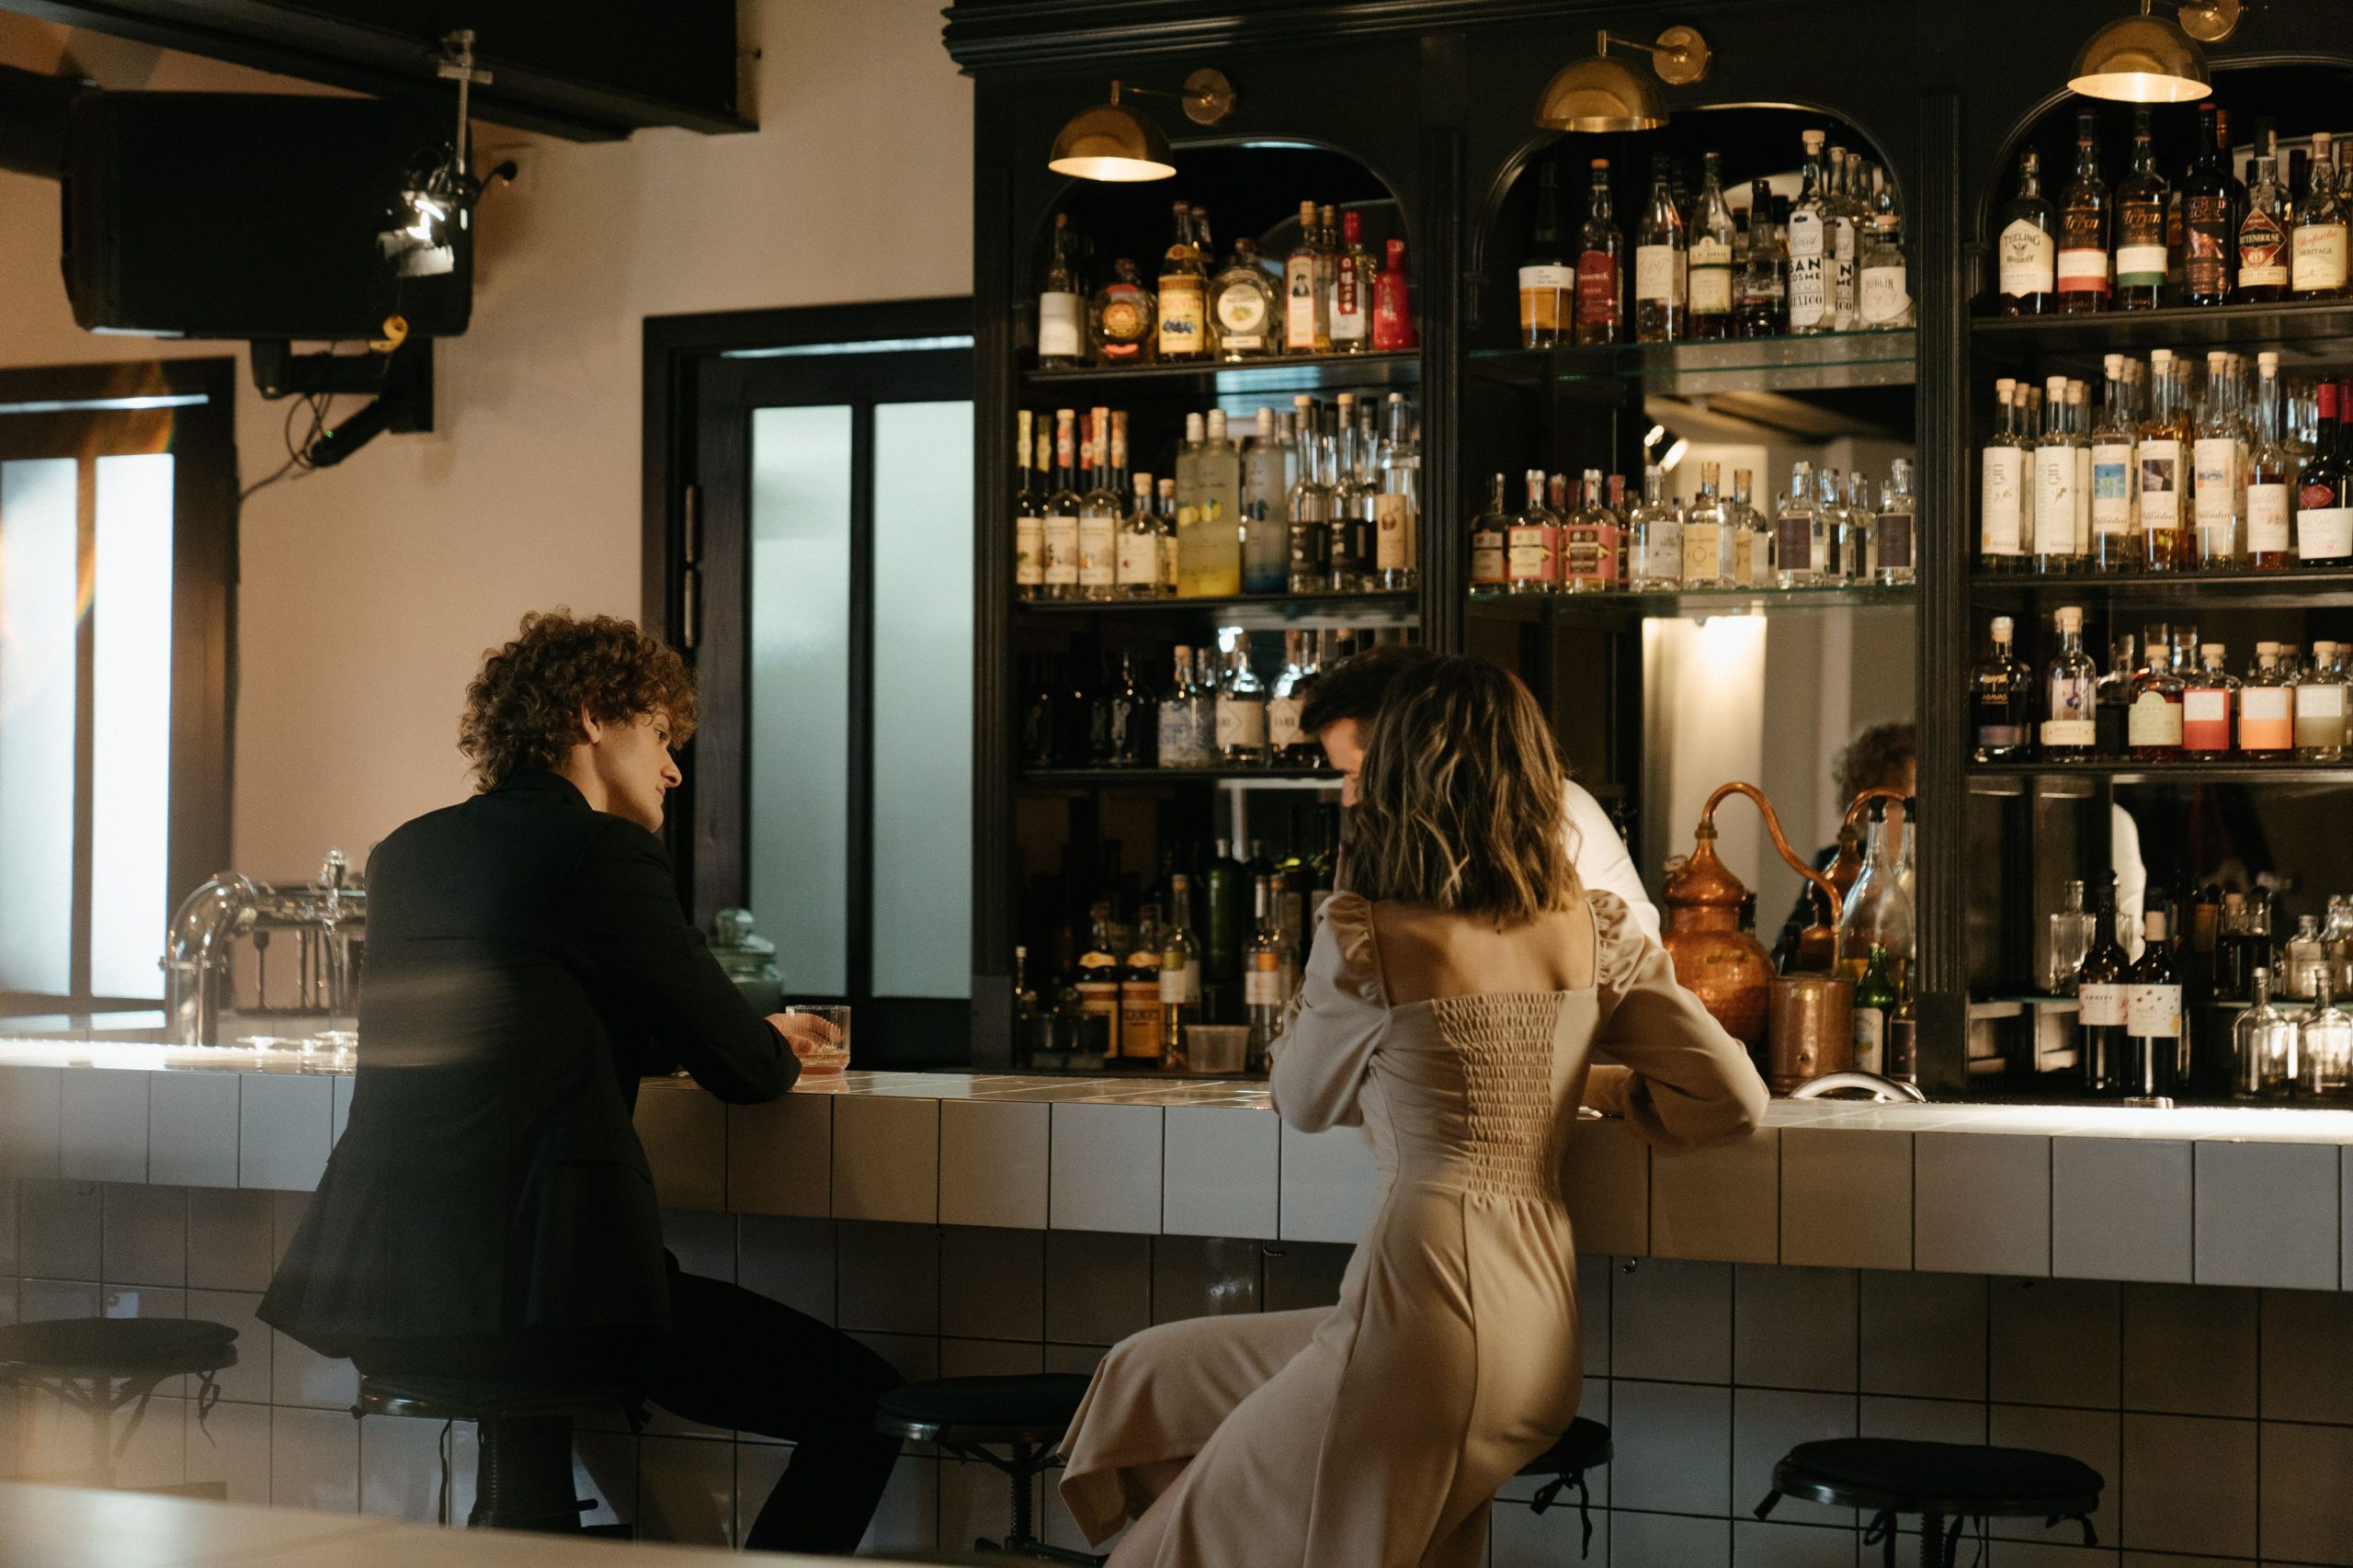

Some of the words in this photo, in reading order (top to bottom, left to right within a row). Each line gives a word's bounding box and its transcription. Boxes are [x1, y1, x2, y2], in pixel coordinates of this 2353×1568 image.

[2063, 215, 2099, 229] Arran
[2004, 233, 2040, 246] TEELING
[2239, 233, 2280, 244] ITTENHOUSE
[2006, 255, 2034, 263] WHISKEY
[1993, 463, 2007, 485] gin
[2048, 463, 2063, 485] gin
[1982, 693, 2007, 701] ABAVAS
